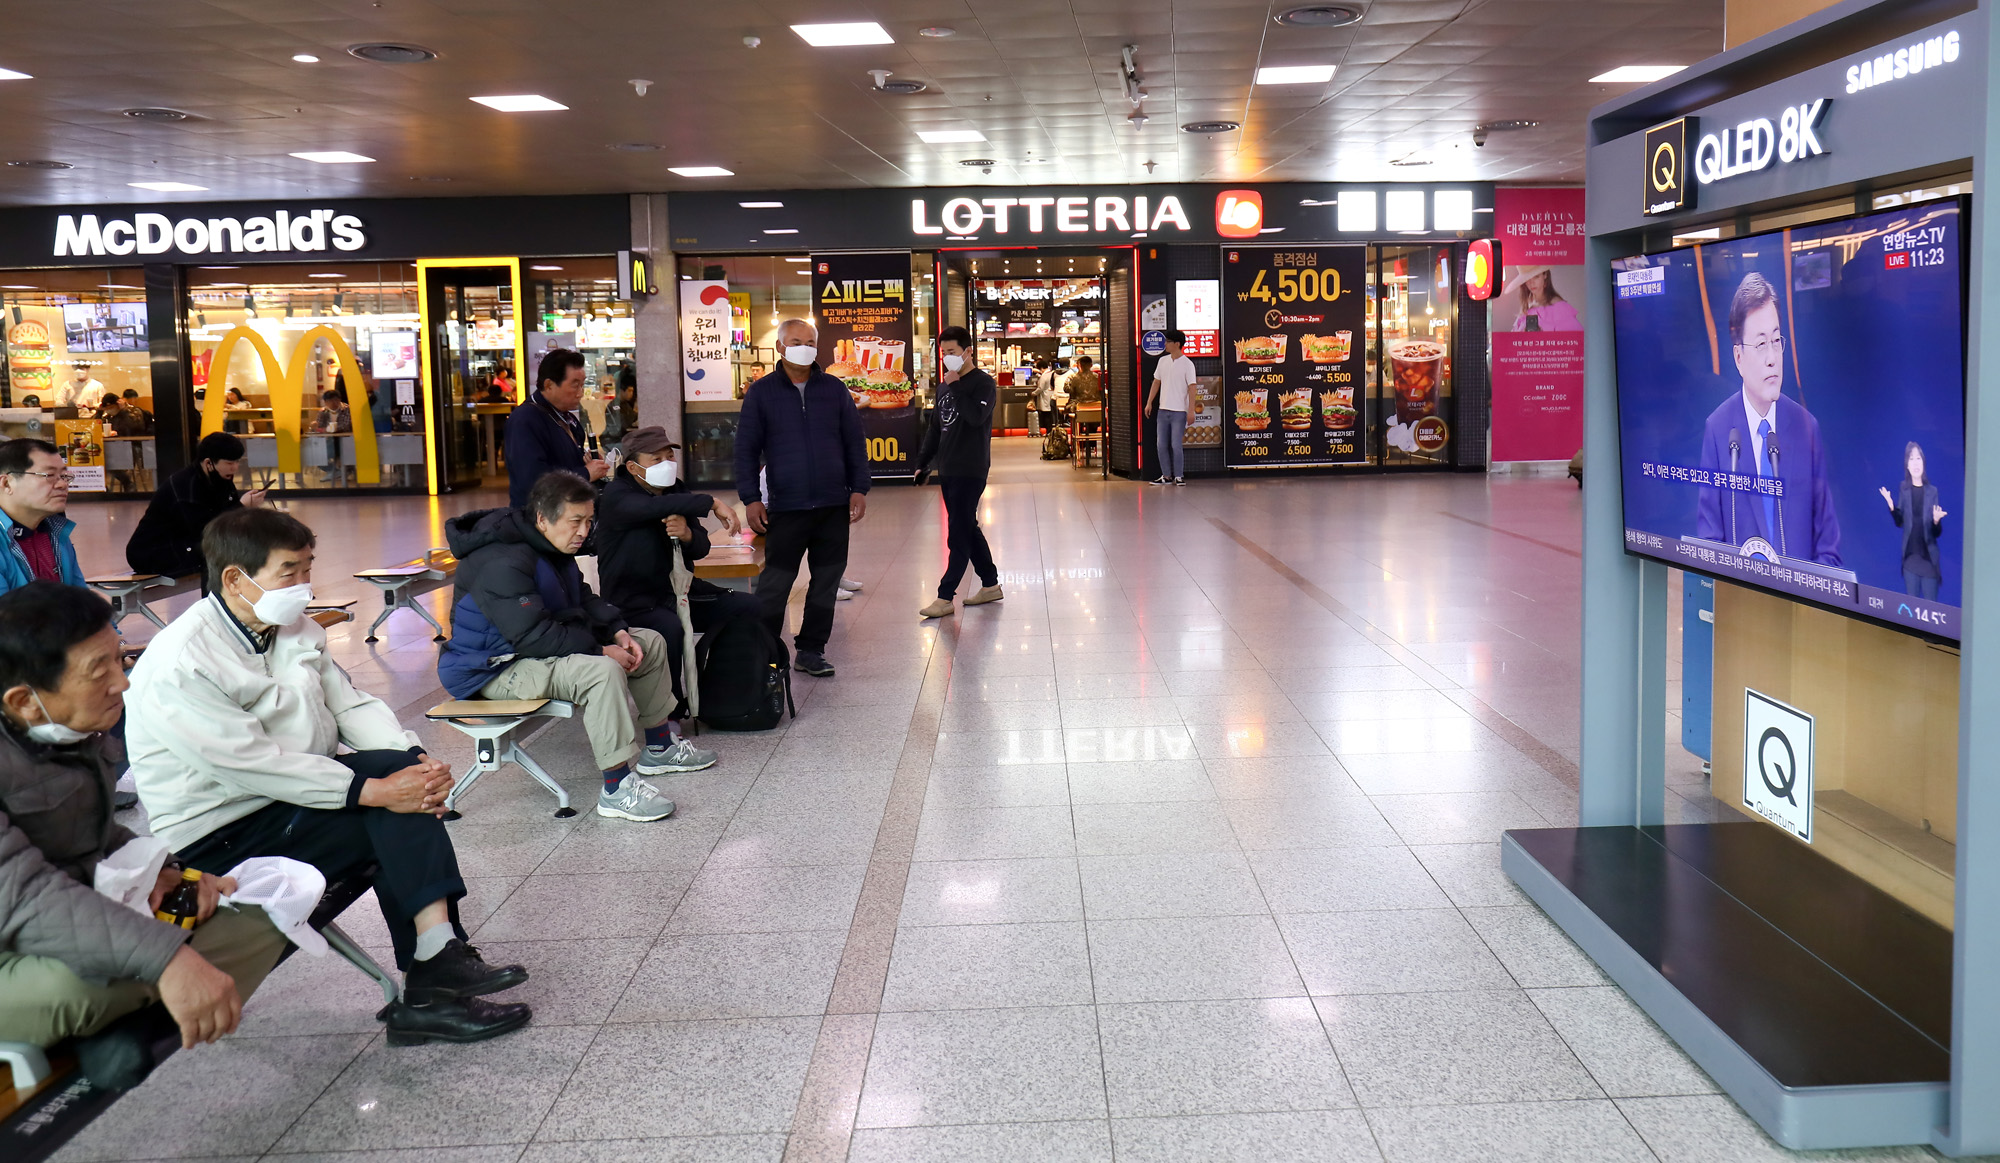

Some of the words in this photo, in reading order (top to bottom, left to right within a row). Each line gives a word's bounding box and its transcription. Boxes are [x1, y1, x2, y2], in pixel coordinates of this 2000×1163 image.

[1846, 30, 1960, 94] SAMSUNG
[1695, 118, 1775, 184] QLED
[1778, 98, 1824, 163] 8K
[912, 196, 1191, 235] LOTTERIA
[1522, 211, 1574, 221] DAEHYUN
[53, 209, 366, 256] McDonald's
[1506, 223, 1528, 236] 대현
[1530, 223, 1552, 236] 패션
[1554, 223, 1585, 236] 그룹전
[1883, 226, 1945, 251] 연합뉴스TV
[1274, 252, 1317, 267] 품격점심
[1889, 255, 1904, 266] LIVE
[1910, 248, 1944, 267] 11:23
[822, 279, 904, 304] 스피드팩
[695, 318, 716, 330] 우리
[692, 332, 720, 346] 함께
[687, 348, 728, 362] 힘내요!
[1642, 462, 1656, 478] 있다,
[1657, 464, 1669, 479] 이런
[1670, 466, 1689, 481] 우려도
[1690, 469, 1712, 485] 있고요.
[1714, 472, 1728, 488] 결국
[1729, 475, 1750, 491] 평범한
[1752, 477, 1783, 497] 시민들을
[1647, 535, 1663, 549] 시위도
[1680, 543, 1697, 558] 브라질
[1698, 547, 1717, 565] 대통령,
[1718, 552, 1742, 569] 코로나19
[1744, 561, 1770, 576] 무시하고
[1771, 566, 1792, 583] 바비큐
[1794, 571, 1831, 593] 파티하려다
[1833, 581, 1849, 597] 취소
[1758, 726, 1798, 808] Q
[1756, 800, 1796, 834] Quantum
